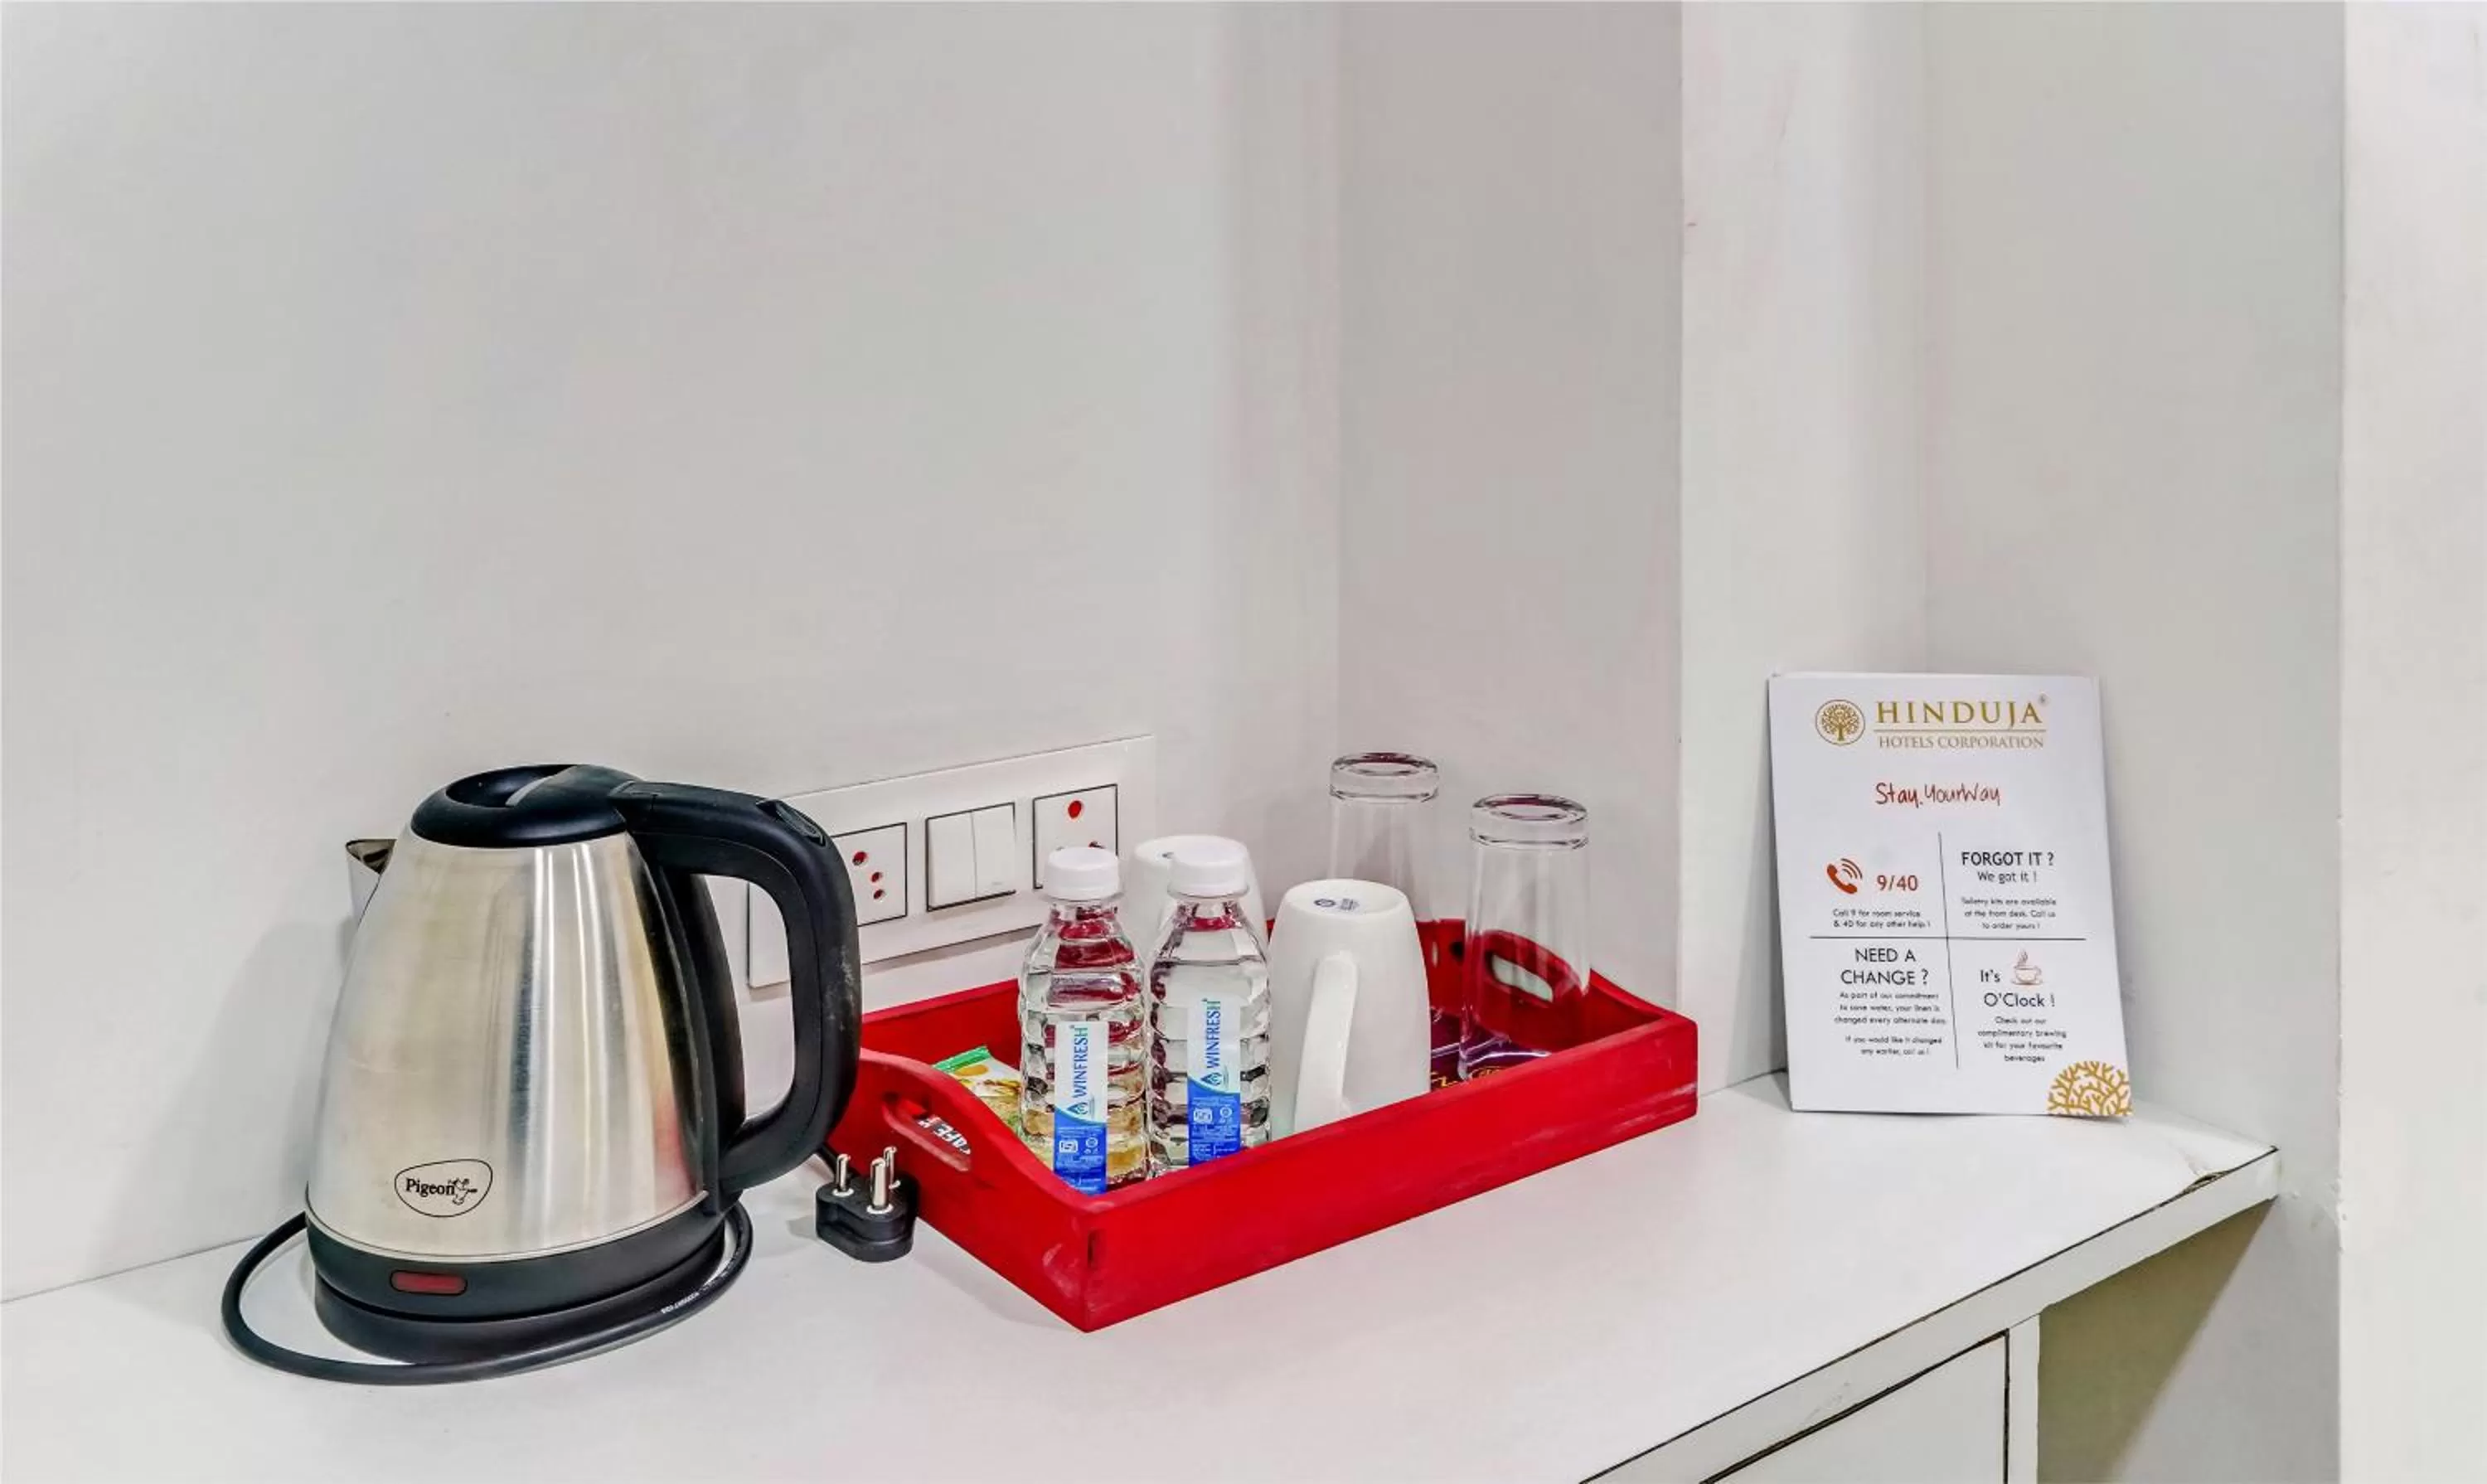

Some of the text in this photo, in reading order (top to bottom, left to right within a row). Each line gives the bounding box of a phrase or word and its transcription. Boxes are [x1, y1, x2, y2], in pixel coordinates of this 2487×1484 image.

[1875, 701, 2043, 727] HINDUJA
[1879, 735, 2043, 748] HOTELS CORPORATION
[1961, 851, 2024, 866] FORGOT
[2029, 851, 2042, 866] IT
[1876, 875, 1918, 891] 9/40
[1977, 871, 1995, 882] We
[1998, 872, 2016, 885] got
[2020, 871, 2029, 883] it
[1854, 948, 1916, 963] NEED A
[1840, 969, 1916, 985] CHANGE
[1980, 969, 2000, 983] It's
[1984, 992, 2045, 1007] O'Clock
[1207, 1001, 1221, 1069] WINFRESH
[1072, 1027, 1088, 1098] WINFRESH
[405, 1177, 455, 1198] Pigeon
